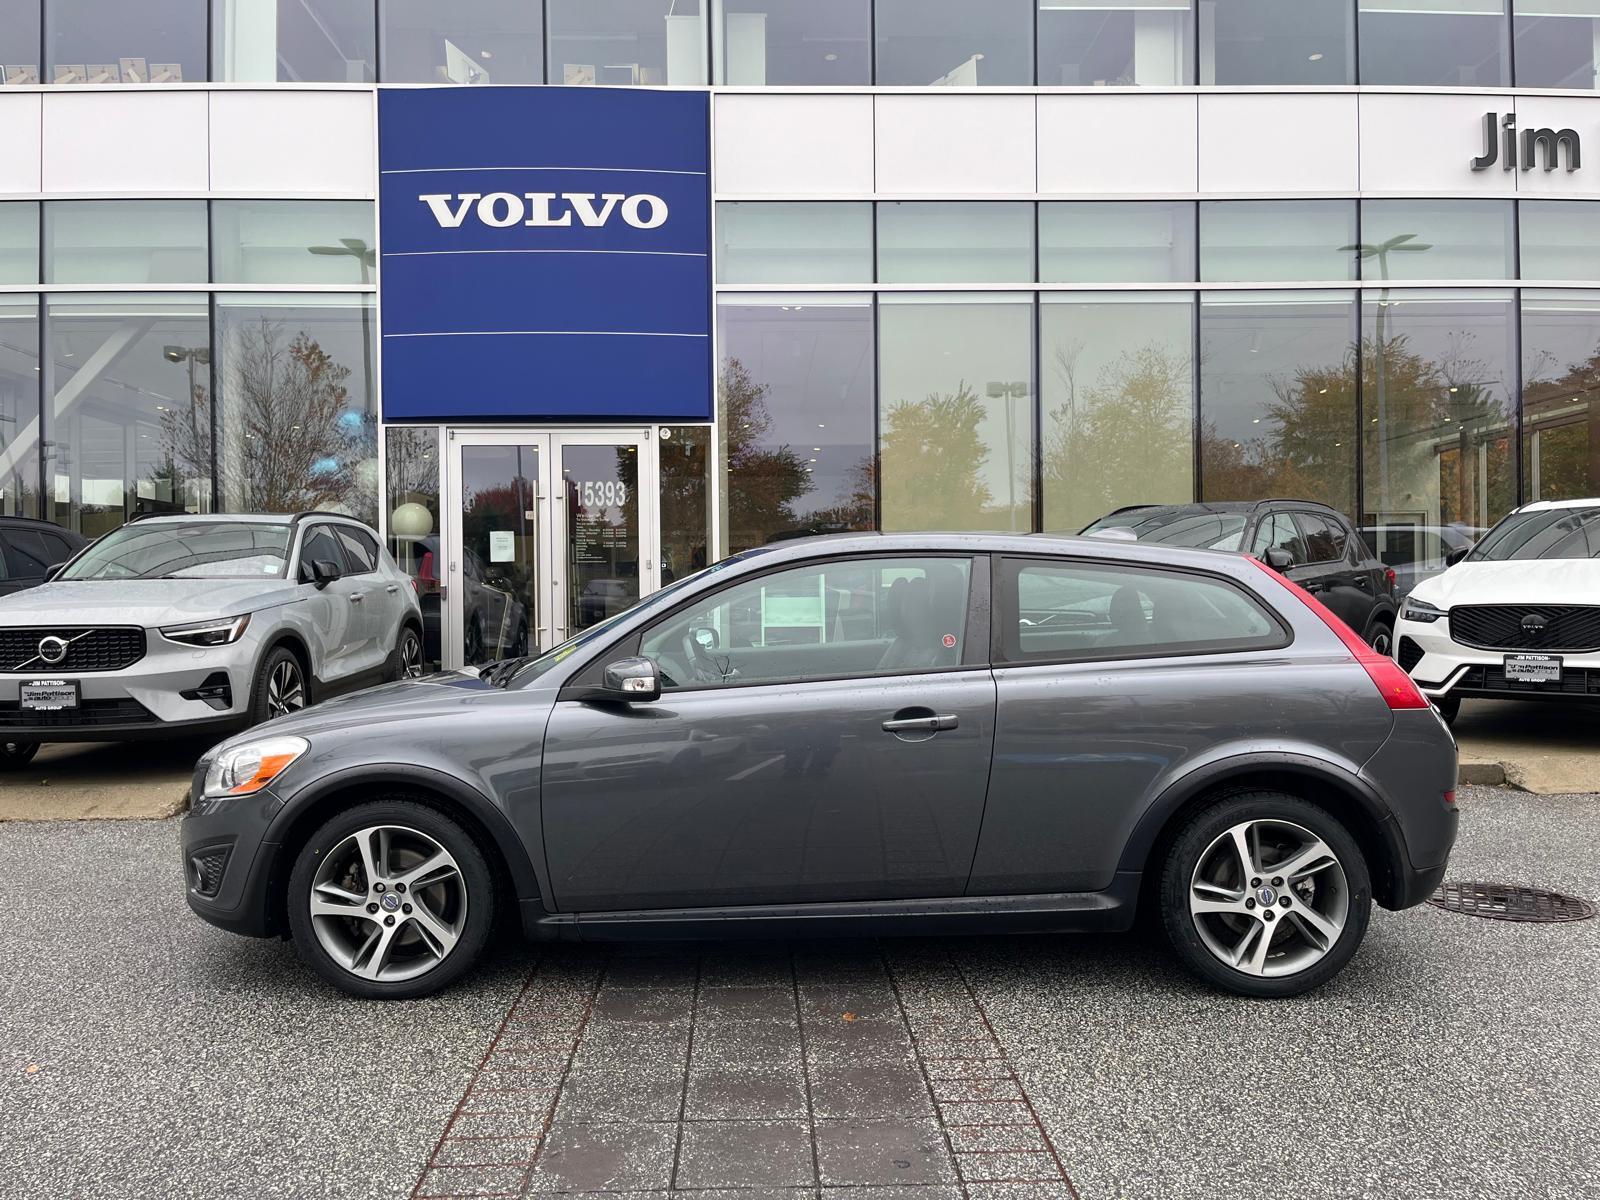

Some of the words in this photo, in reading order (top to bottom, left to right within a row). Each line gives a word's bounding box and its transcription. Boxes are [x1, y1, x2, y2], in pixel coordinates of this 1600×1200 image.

[1470, 113, 1581, 172] Jim
[418, 192, 669, 229] VOLVO
[575, 481, 626, 507] 15393
